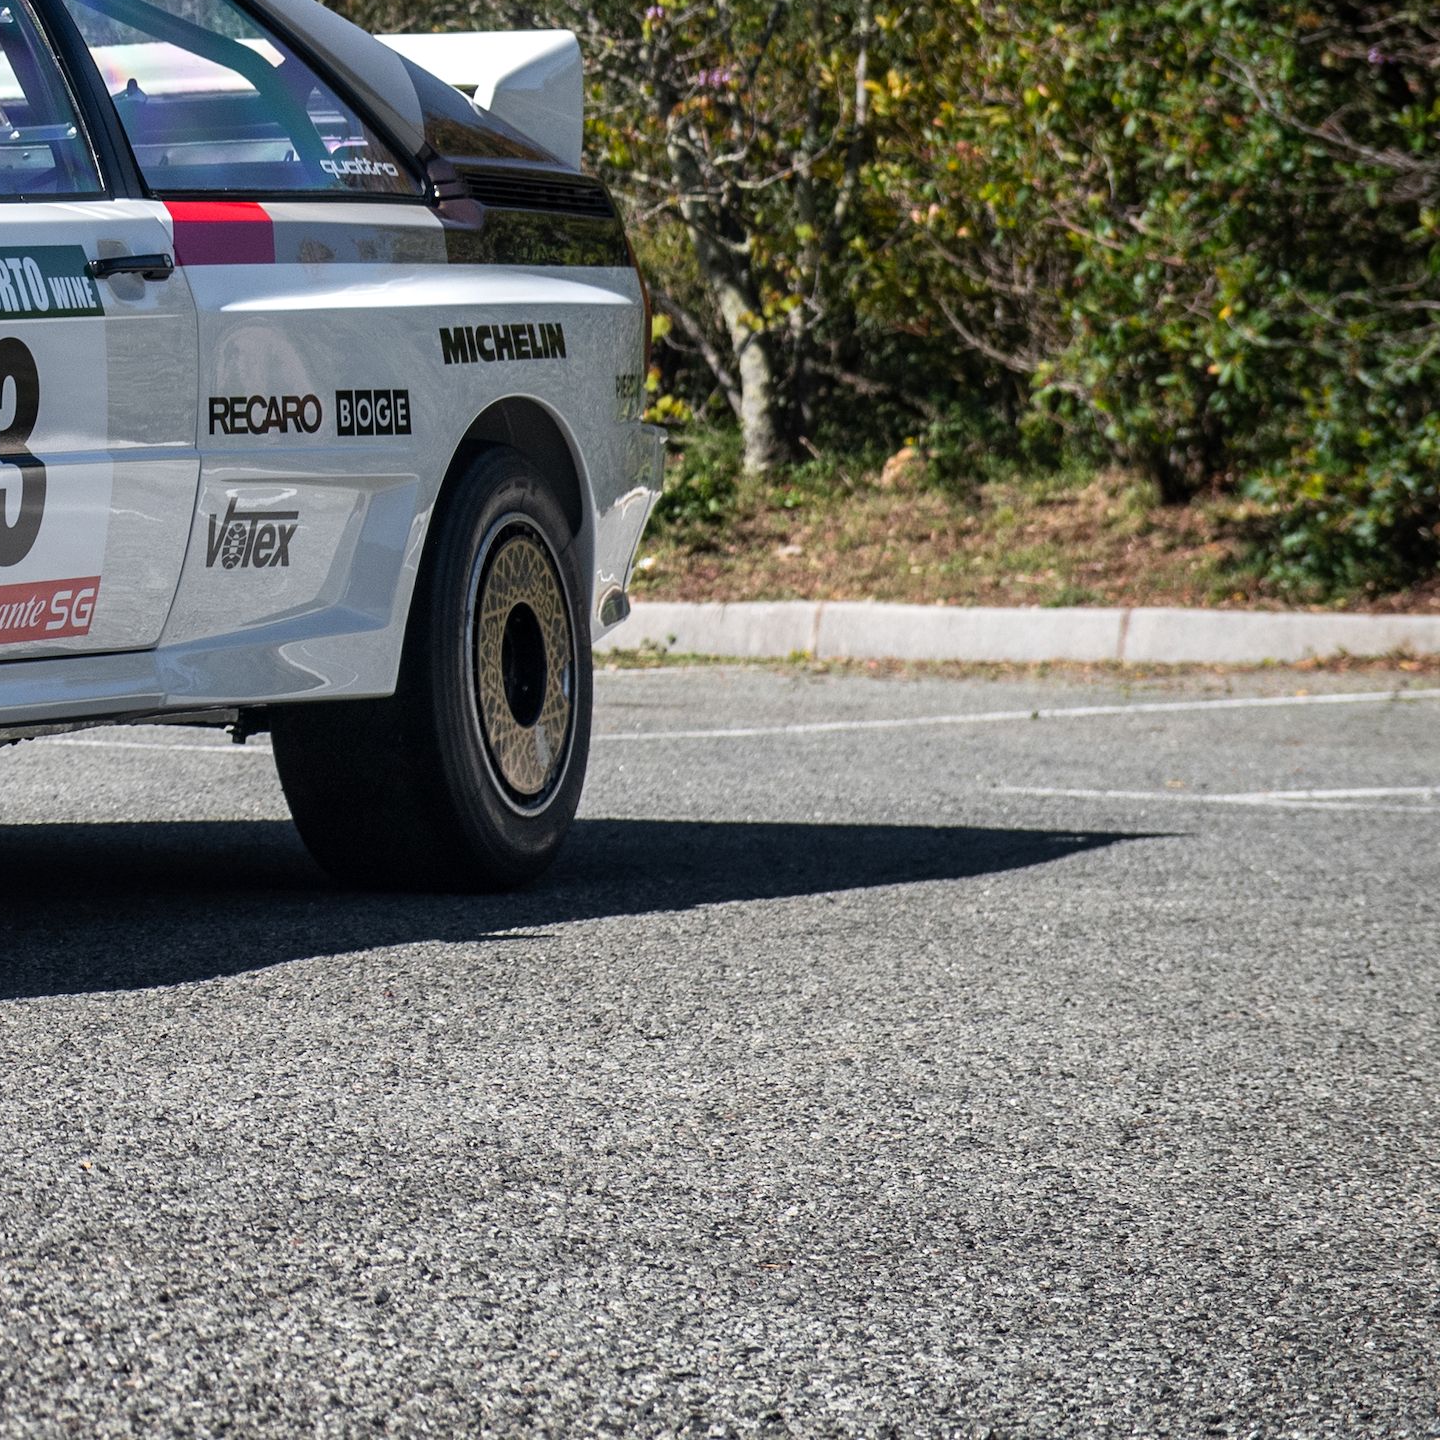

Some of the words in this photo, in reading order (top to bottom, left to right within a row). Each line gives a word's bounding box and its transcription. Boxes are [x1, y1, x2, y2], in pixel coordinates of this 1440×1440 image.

[320, 157, 399, 180] quattro
[47, 276, 97, 309] WINE
[439, 323, 567, 364] MICHELIN
[208, 394, 323, 435] RECARO
[338, 397, 410, 428] BOGE
[45, 588, 94, 632] SG
